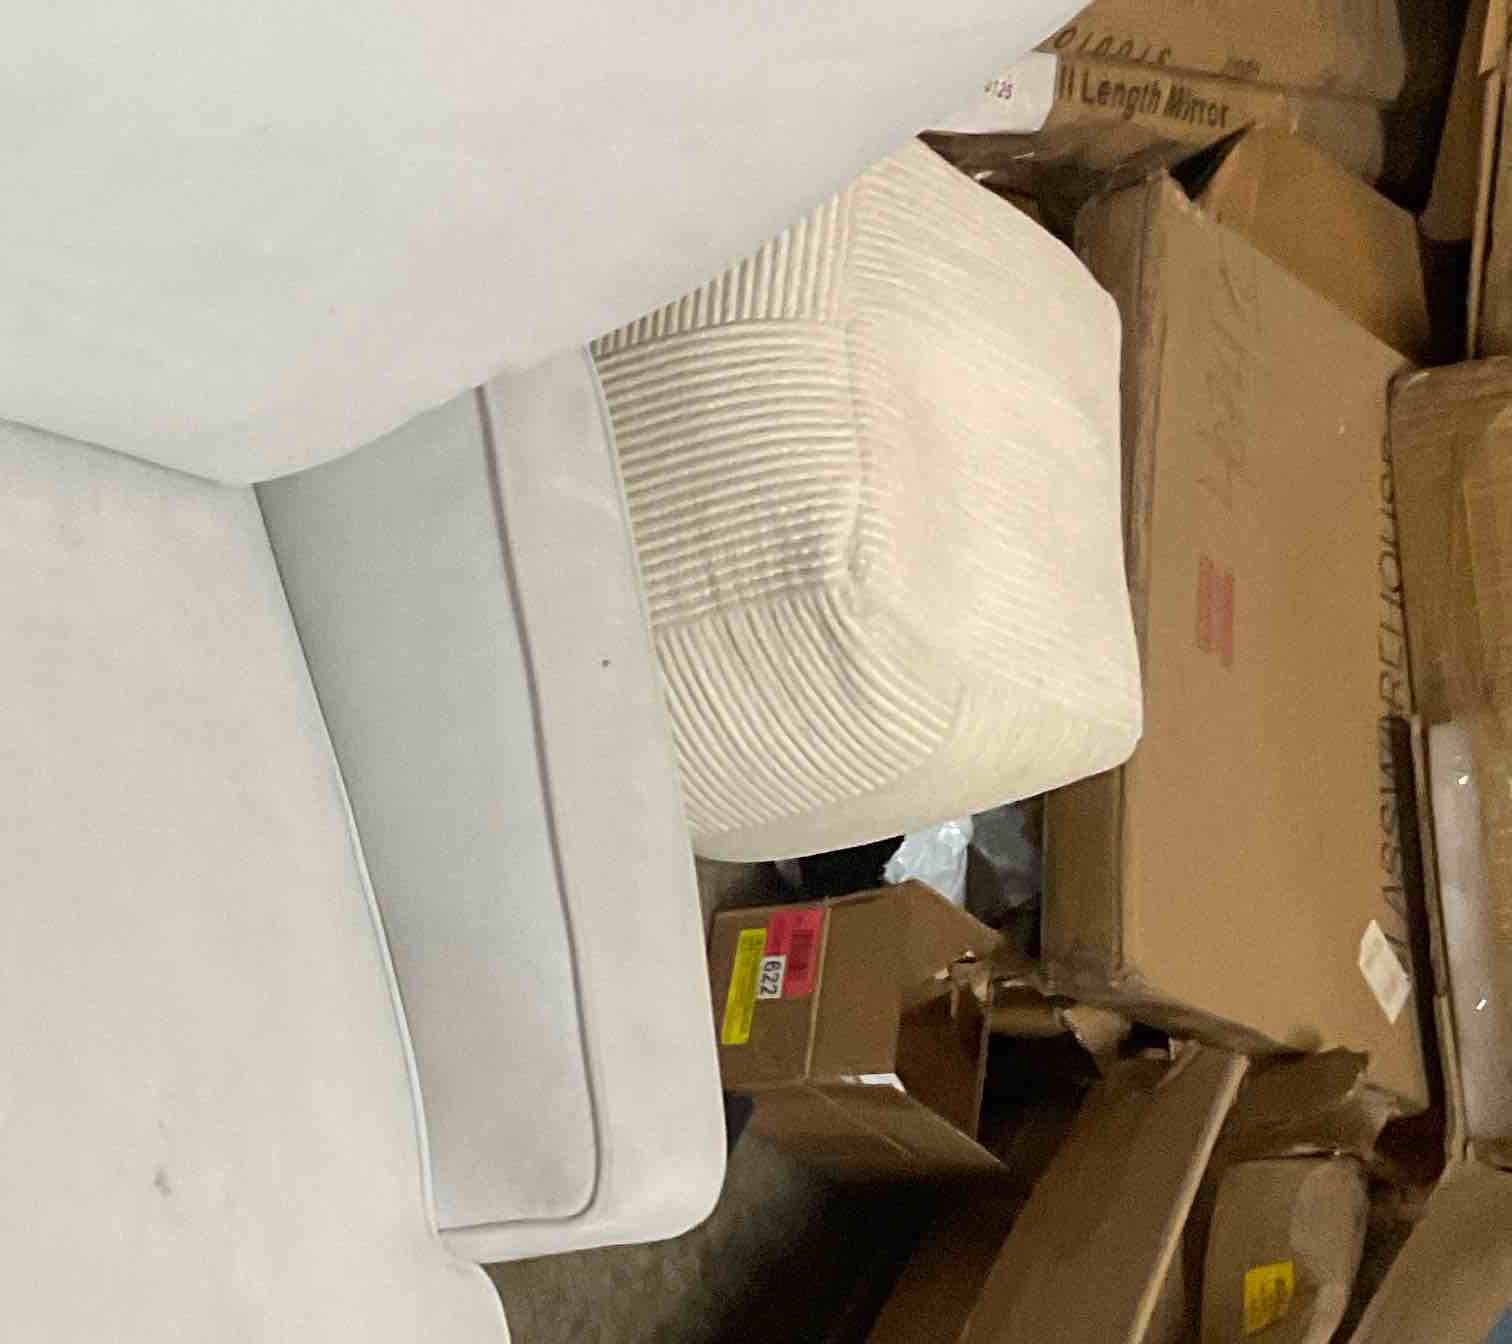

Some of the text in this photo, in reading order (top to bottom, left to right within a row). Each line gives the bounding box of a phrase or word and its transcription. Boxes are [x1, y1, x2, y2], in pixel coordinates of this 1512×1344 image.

[1081, 72, 1162, 120] Length
[1163, 83, 1230, 128] Mirror
[760, 960, 782, 995] 622
